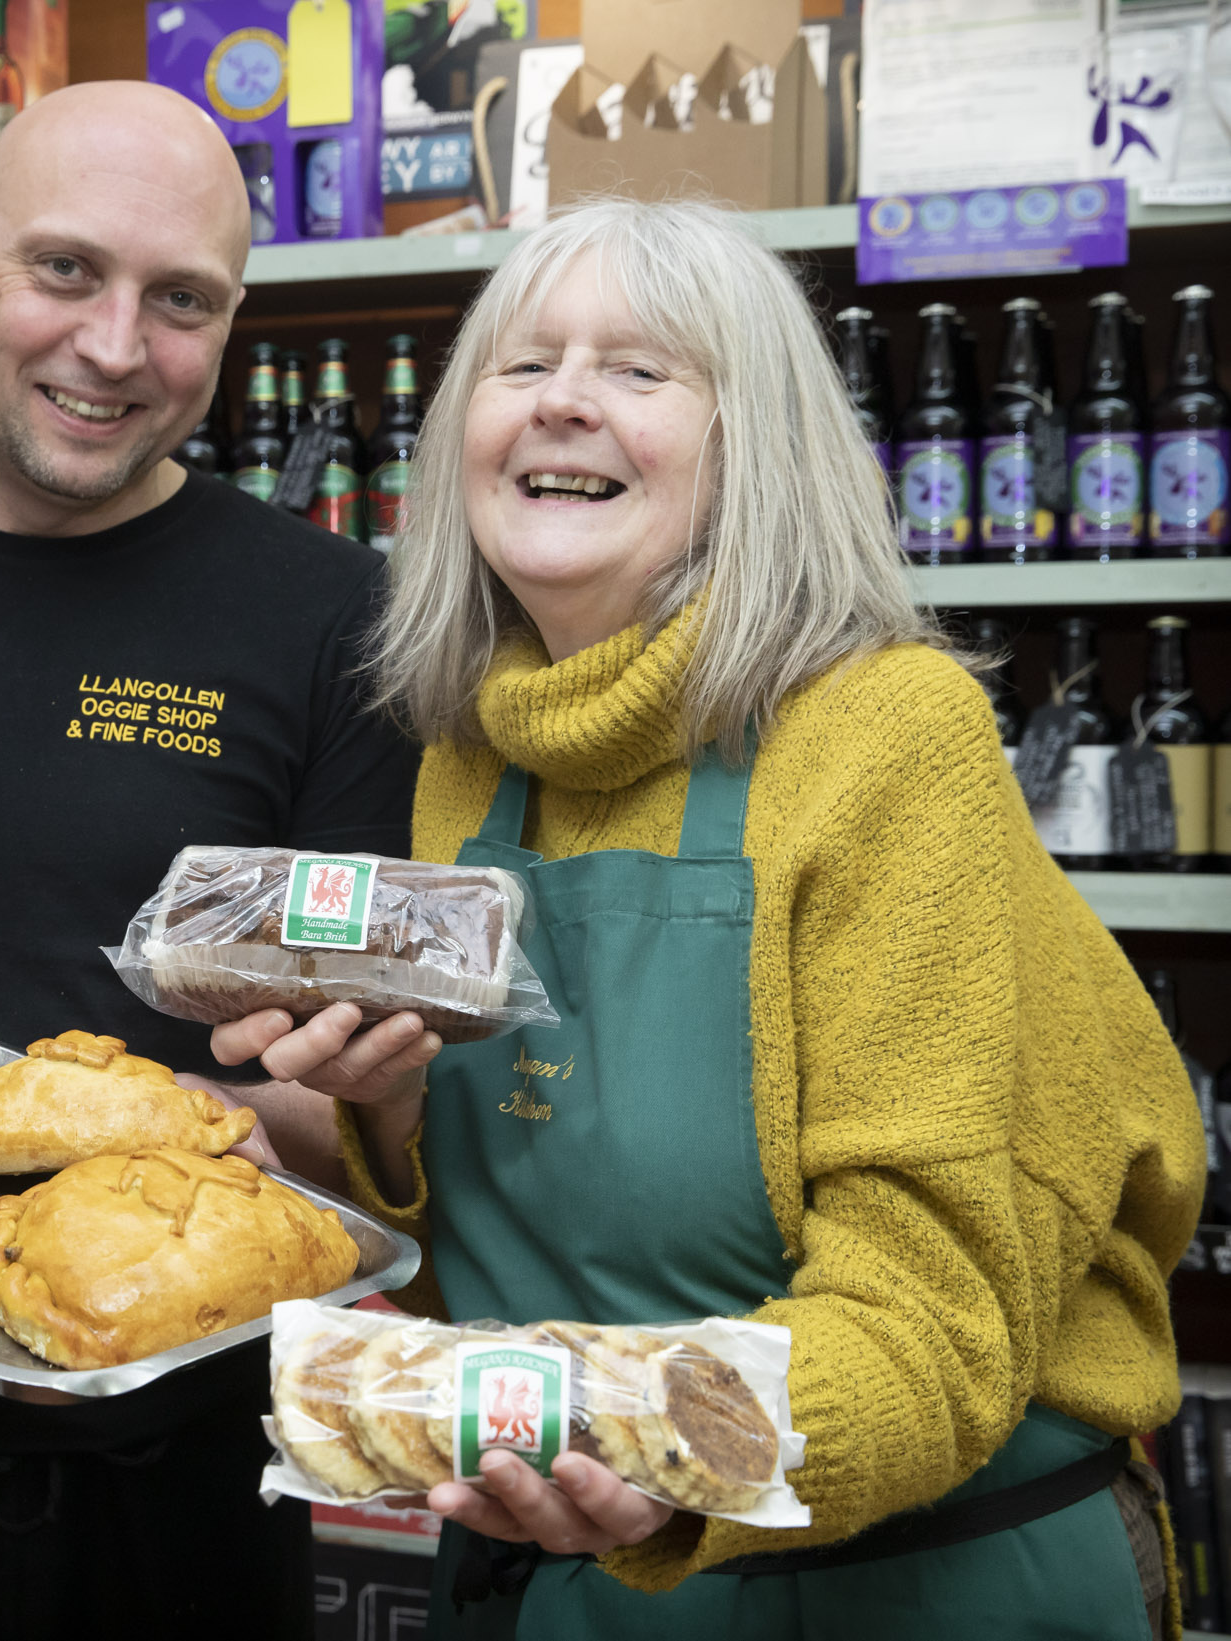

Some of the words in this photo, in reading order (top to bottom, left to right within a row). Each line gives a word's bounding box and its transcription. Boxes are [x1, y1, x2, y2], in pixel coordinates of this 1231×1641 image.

[79, 674, 225, 711] LLANGOLLEN
[81, 697, 152, 721] OGGIE
[156, 706, 218, 730] SHOP
[66, 719, 83, 739] &
[89, 721, 138, 742] FINE
[142, 727, 222, 757] FOODS
[301, 918, 348, 930] Handmade
[301, 930, 322, 939] Bara
[324, 931, 347, 941] Brith
